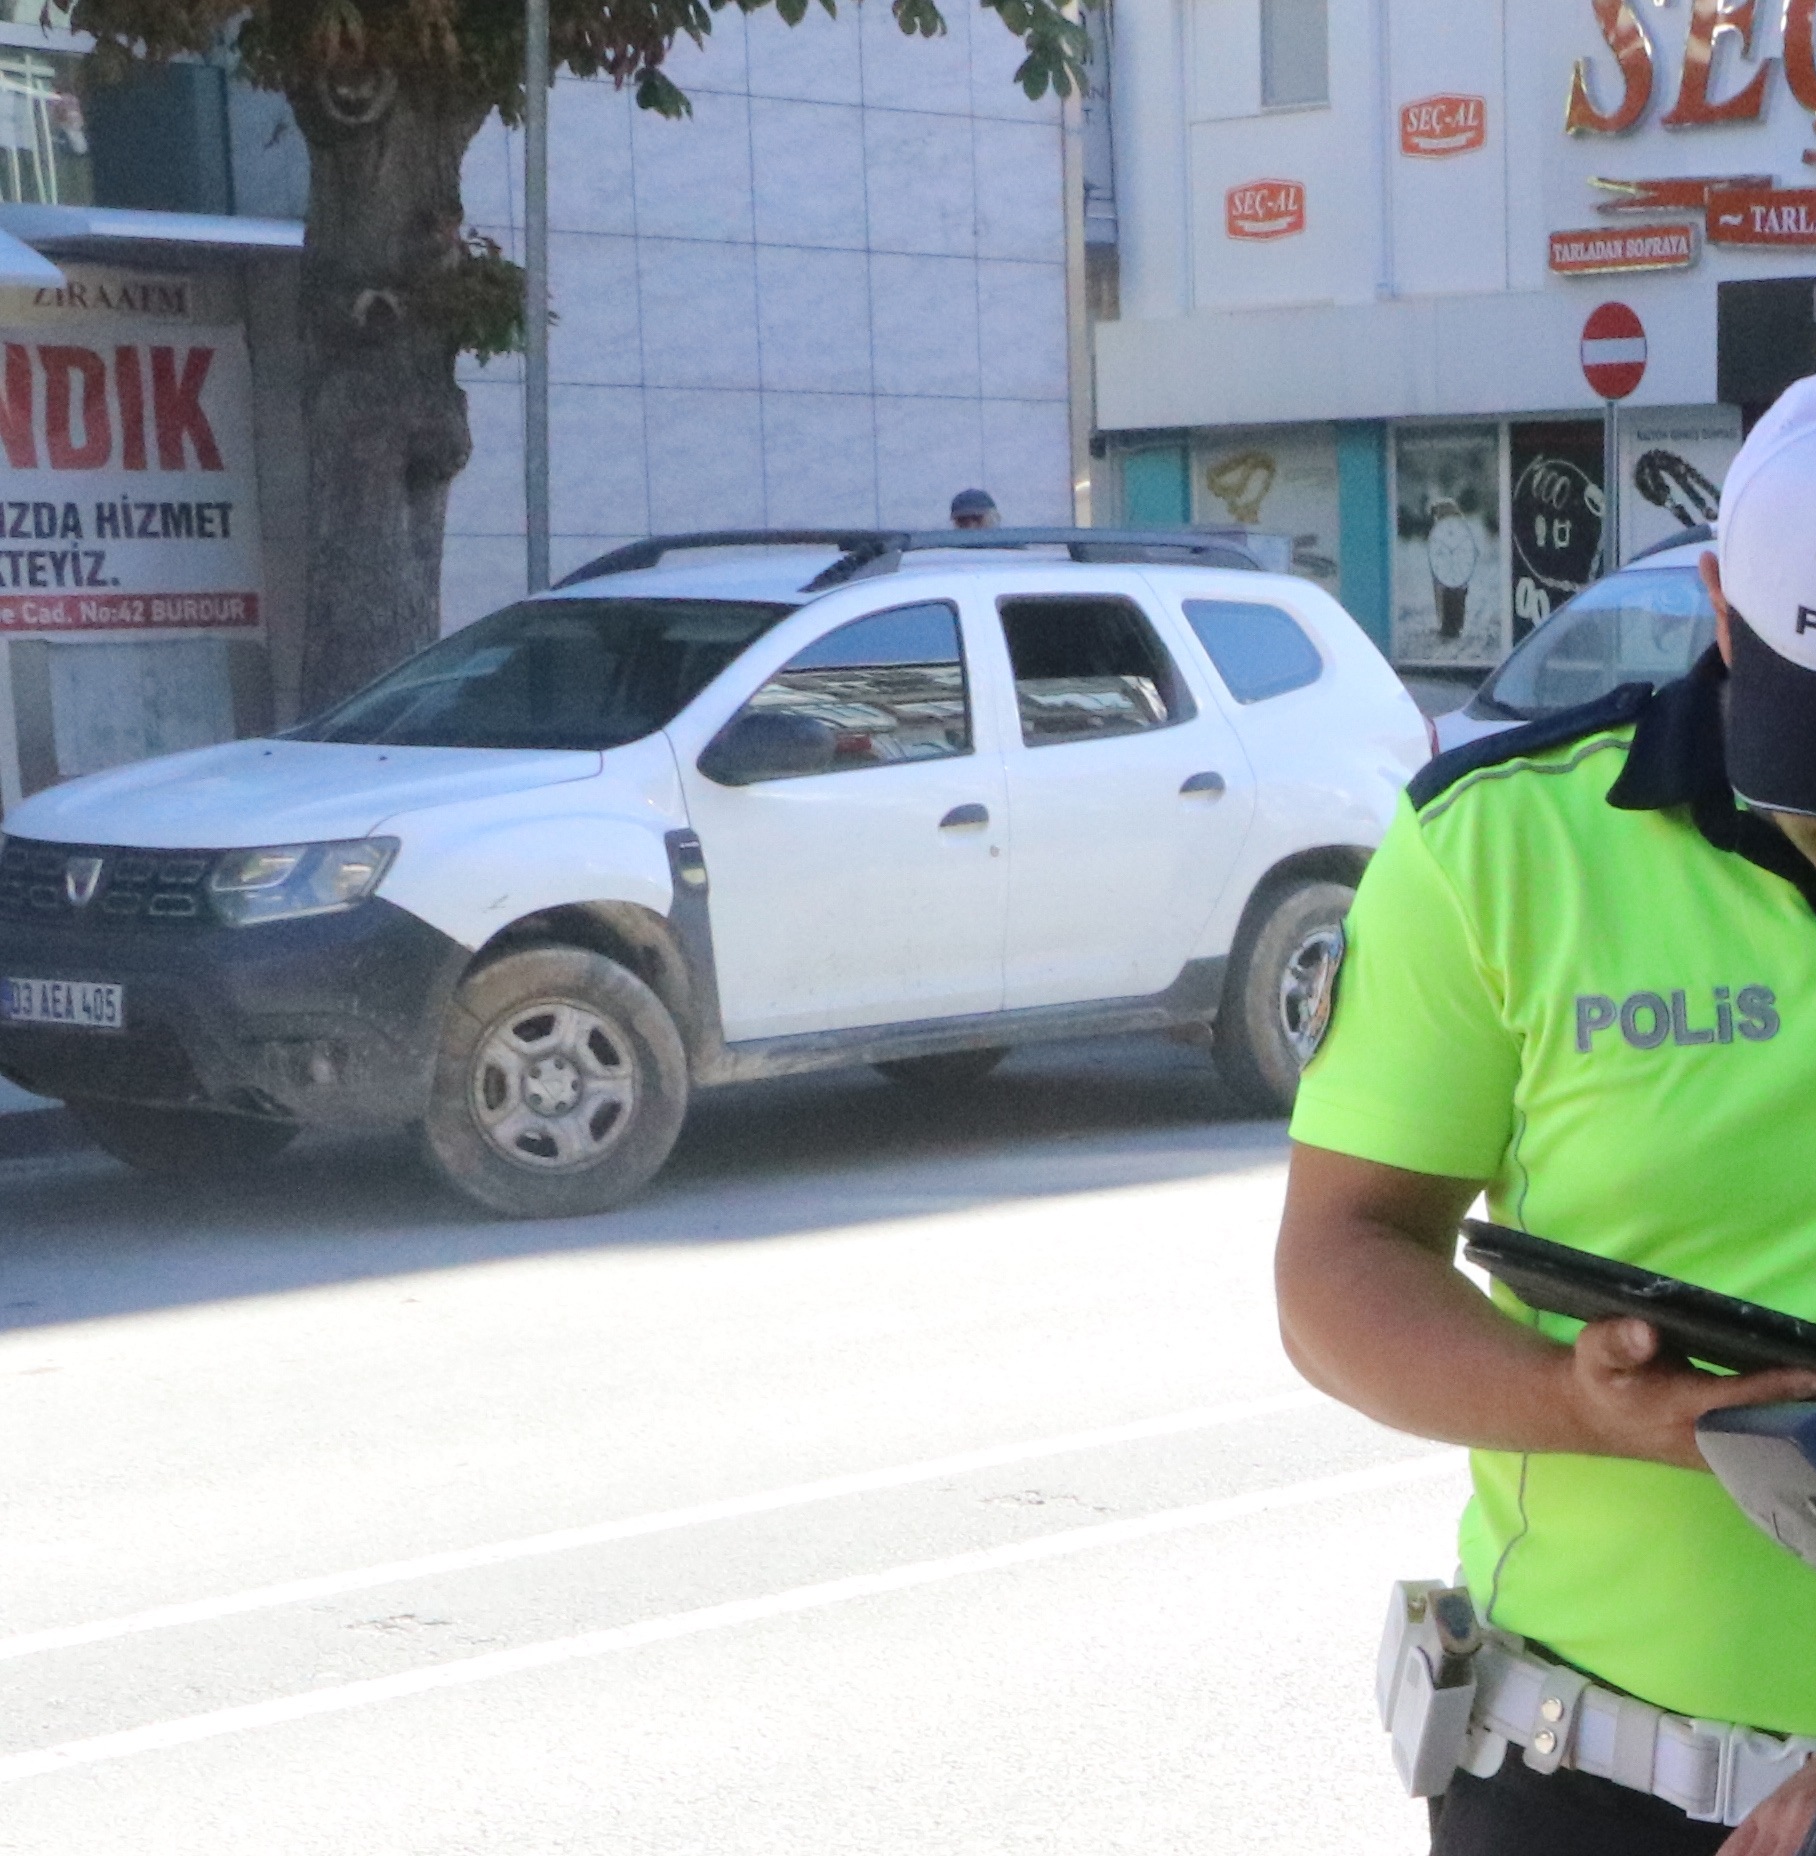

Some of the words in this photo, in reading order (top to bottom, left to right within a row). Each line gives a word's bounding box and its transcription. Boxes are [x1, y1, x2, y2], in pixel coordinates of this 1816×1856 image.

[1406, 101, 1479, 134] SEÇ-AL
[1232, 187, 1298, 218] SEÇ-AL
[1552, 238, 1624, 264] TARLADAN
[1624, 234, 1691, 260] SOFRAYA
[95, 494, 234, 540] HİZMET
[22, 604, 73, 626] Cad.
[80, 604, 147, 624] No:42
[150, 600, 246, 623] BURDUR
[11, 982, 33, 1016] 03
[40, 983, 76, 1019] AEA
[81, 985, 117, 1023] 405
